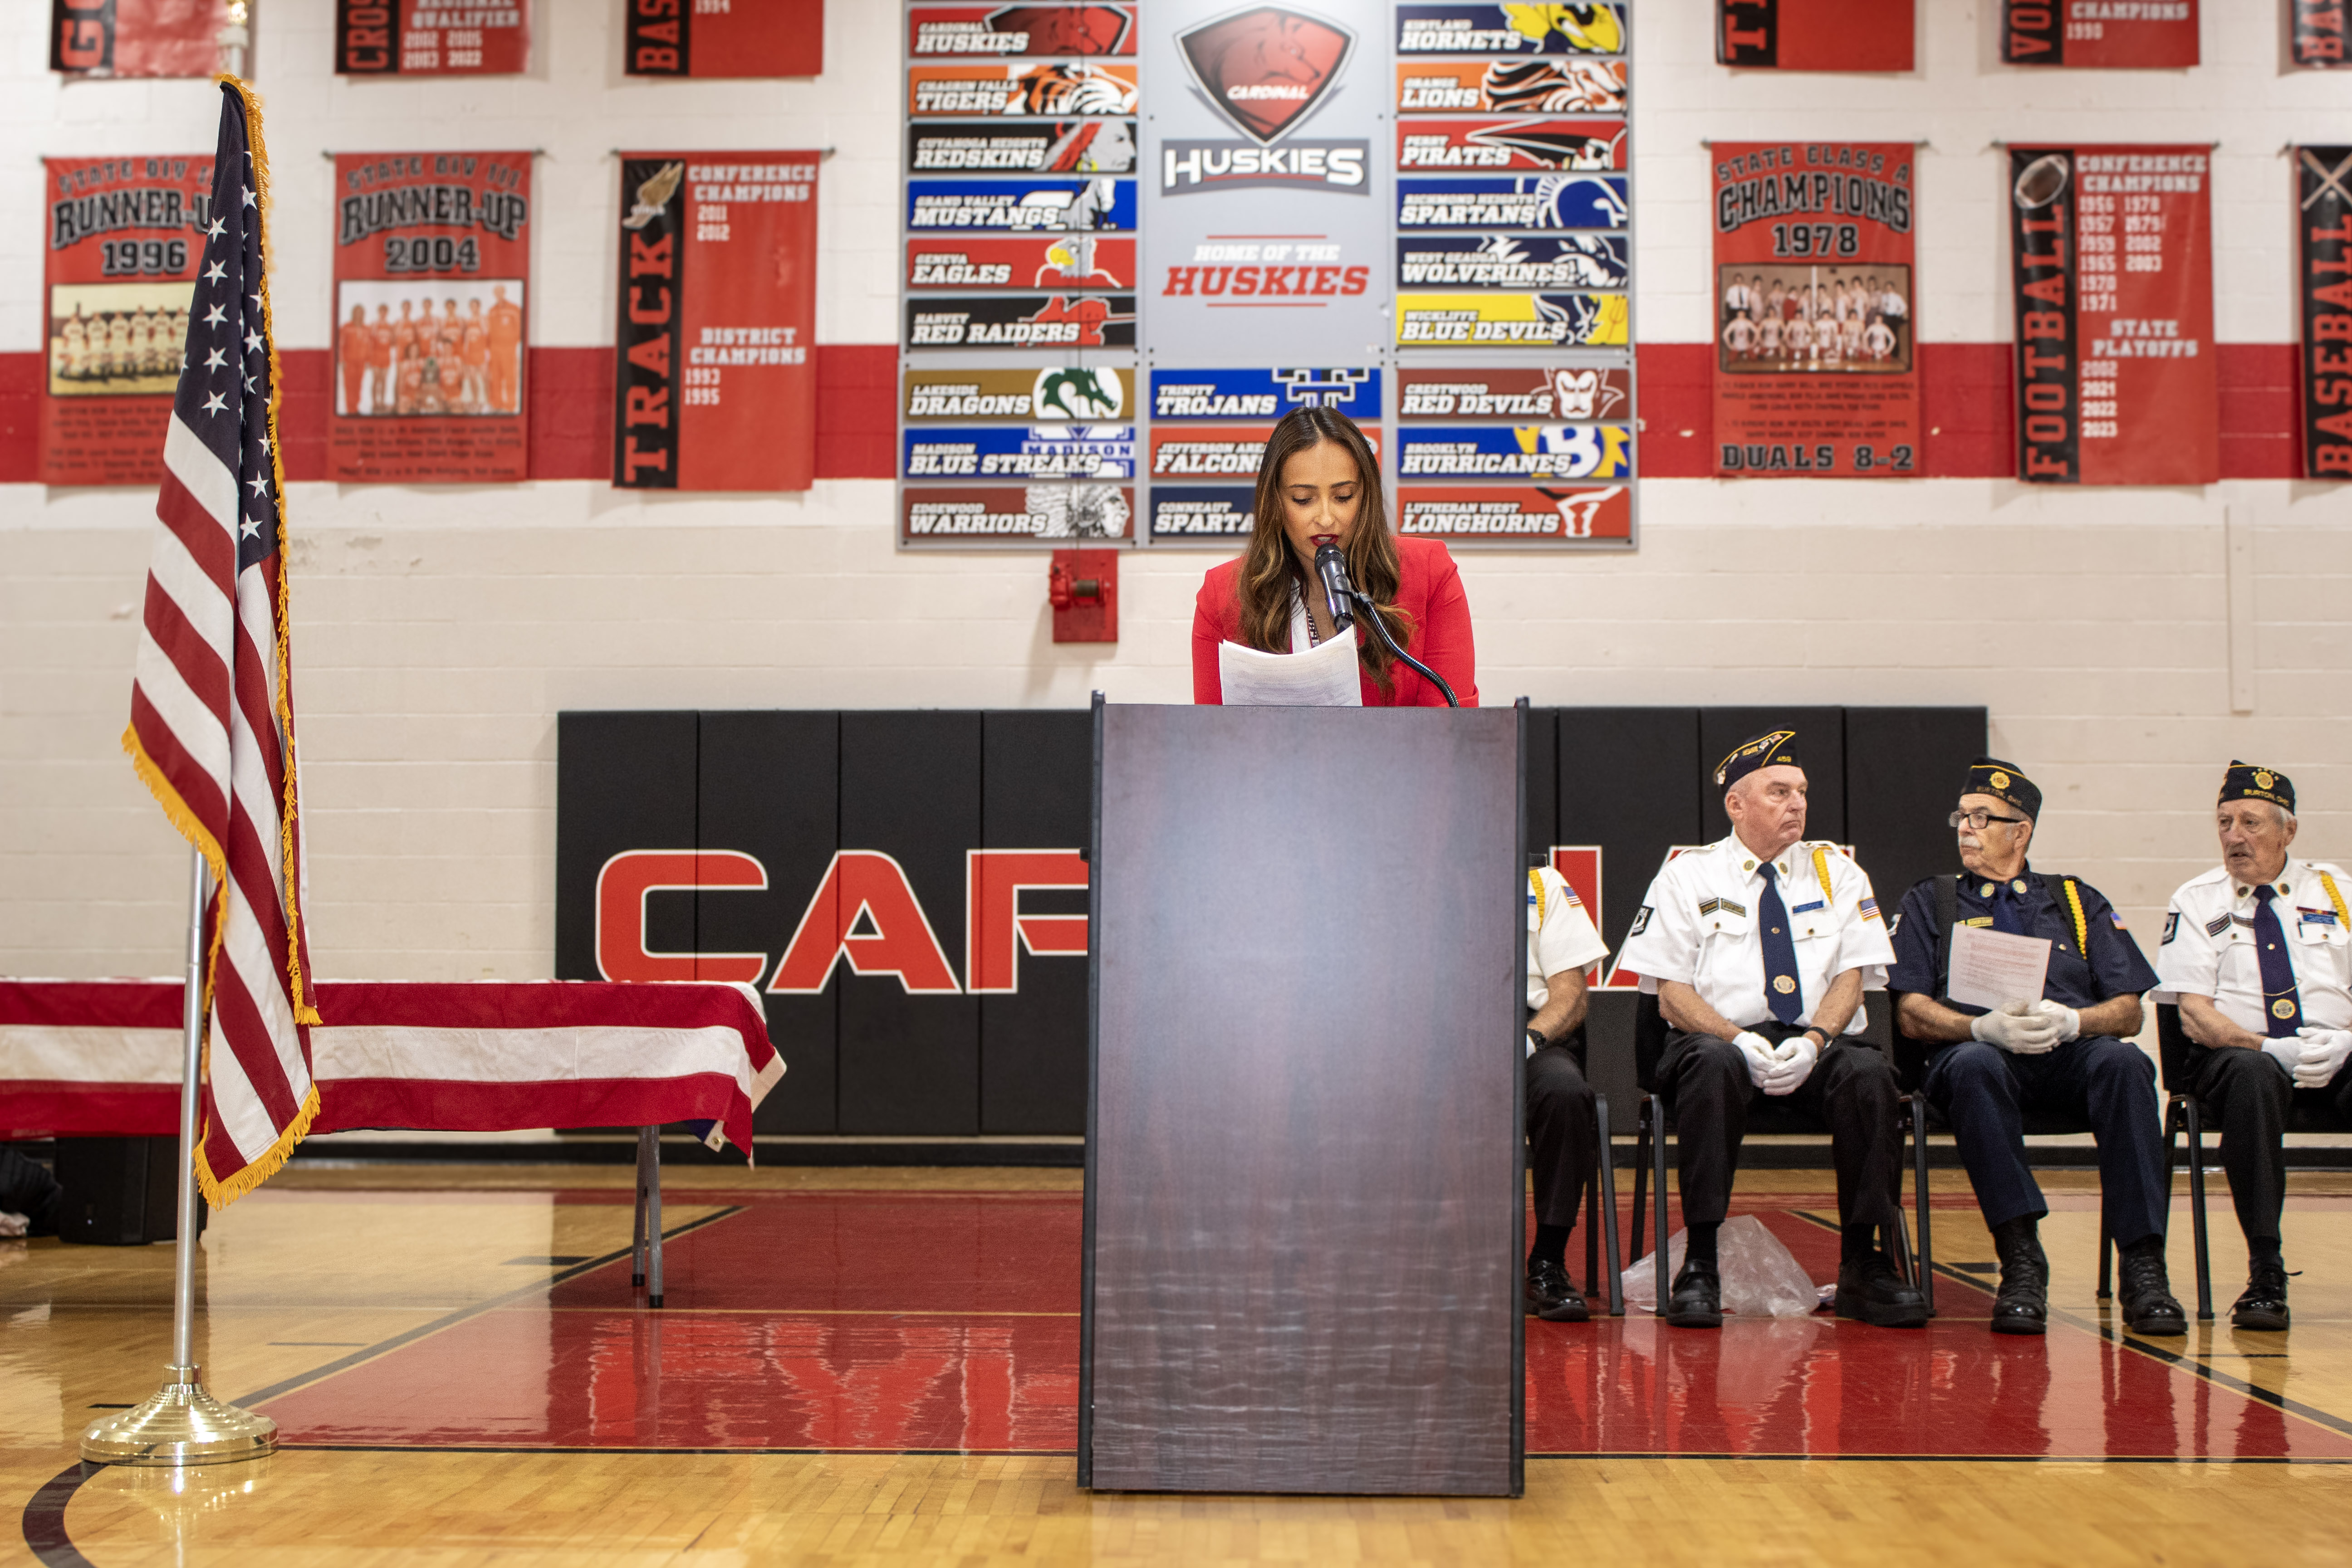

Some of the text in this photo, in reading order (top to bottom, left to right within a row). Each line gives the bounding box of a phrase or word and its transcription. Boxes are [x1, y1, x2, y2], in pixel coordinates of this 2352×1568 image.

[412, 10, 519, 29] QUALIFIER
[2071, 2, 2189, 20] CHAMPIONS
[347, 0, 389, 69] CRO
[2010, 0, 2052, 57] VO
[916, 32, 1029, 53] HUSKIES
[1400, 31, 1522, 50] HORNETS
[979, 81, 1019, 91] FALLS
[1227, 85, 1310, 100] CARDINAL
[916, 92, 1008, 111] TIGERS
[1400, 88, 1480, 107] LIONS
[914, 149, 1044, 168] REDSKINS
[1400, 147, 1512, 166] PIRATES
[1716, 145, 1910, 184] STATE CLASS A
[2076, 155, 2206, 173] CONFERENCE
[59, 160, 132, 194] STATE
[146, 159, 188, 180] DIV
[347, 156, 422, 189] STATE
[435, 156, 477, 177] DIV
[688, 165, 816, 182] CONFERENCE
[1164, 148, 1364, 188] HUSKIES
[2083, 174, 2201, 192] CHAMPIONS
[694, 185, 810, 202] CHAMPIONS
[964, 195, 1016, 206] VALLEY
[1718, 171, 1911, 233] CHAMPIONS
[51, 187, 212, 250] RUNNER-U
[339, 185, 528, 246] RUNNER-UP
[697, 205, 727, 222] 2011
[911, 207, 1059, 226] MUSTANGS
[1400, 205, 1536, 225] SPARTANS
[696, 224, 730, 241] 2012
[1771, 223, 1859, 257] 1978
[100, 239, 187, 275] 1996
[385, 236, 480, 272] 2004
[915, 254, 968, 264] GENEVA
[1193, 243, 1341, 262] HOME OF THE
[1405, 252, 1443, 263] WEST
[911, 265, 1011, 284] EAGLES
[1162, 265, 1370, 296] HUSKIES
[1402, 263, 1570, 283] WOLVERINES
[2081, 294, 2117, 311] 1971
[914, 313, 970, 324] HARVEY
[1405, 311, 1478, 322] WICKLIFFE
[701, 328, 797, 345] DISTRICT
[911, 323, 1081, 344] RED RAIDERS
[1401, 322, 1568, 341] BLUE DEVILS
[2111, 320, 2179, 337] STATE
[2022, 205, 2068, 476] FOOTBALL
[2092, 340, 2198, 357] PLAYOFFS
[2311, 214, 2352, 472] BASEBALL
[624, 233, 673, 483] TRACK
[690, 347, 806, 365] CHAMPIONS
[685, 368, 720, 385] 1993
[684, 388, 720, 405] 1995
[913, 385, 979, 396] LAKESIDE
[1158, 385, 1216, 396] TRINITY
[1405, 384, 1488, 395] CRESTWOOD
[2082, 381, 2116, 397] 2021
[908, 396, 1031, 415] DRAGONS
[1156, 395, 1278, 415] TROJANS
[1401, 395, 1553, 415] RED DEVILS
[2082, 401, 2117, 418] 2022
[2082, 421, 2117, 437] 2023
[912, 444, 976, 455] MADISON
[1029, 445, 1130, 458] MADISON
[1157, 442, 1235, 453] JEFFERSON
[1405, 443, 1477, 454] BROOKLYN
[1719, 443, 1914, 471] DUALS 8-2
[908, 454, 1102, 474] BLUE STREAKS
[1153, 454, 1264, 473] FALCON
[1401, 454, 1572, 474] HURRICANES
[911, 503, 985, 514] EDGEWOOD
[1157, 502, 1232, 513] CONNEAUT
[1405, 503, 1521, 513] LUTHERAN WEST
[909, 514, 1048, 533] WARRIORS
[1153, 513, 1254, 532] SPARTA
[1401, 513, 1559, 533] LONGHORNS
